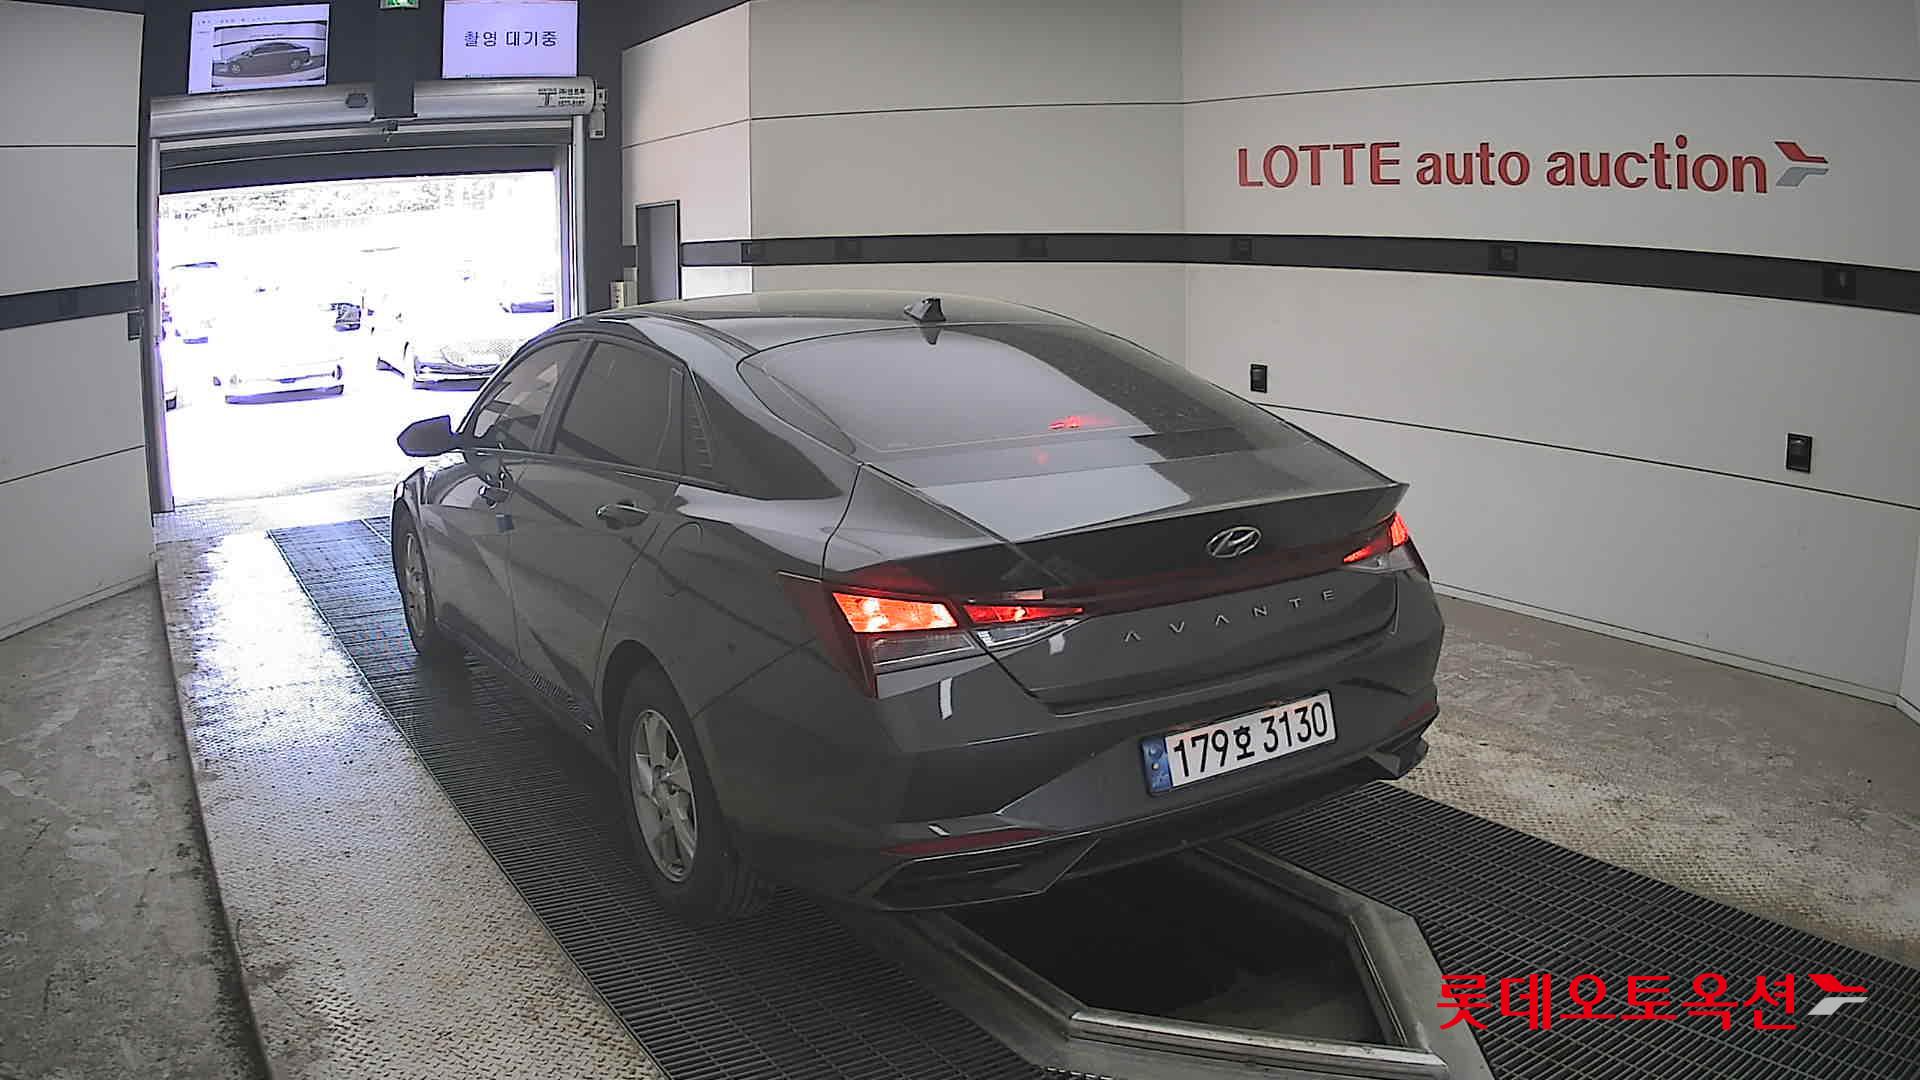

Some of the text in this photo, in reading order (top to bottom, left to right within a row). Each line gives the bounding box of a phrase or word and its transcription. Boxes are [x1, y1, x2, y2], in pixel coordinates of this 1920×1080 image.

[464, 31, 558, 48] 촬영 대기중
[1237, 134, 1768, 194] LOTTE auto auction
[1124, 589, 1335, 643] AVANTE
[1173, 702, 1328, 778] 179호 3130
